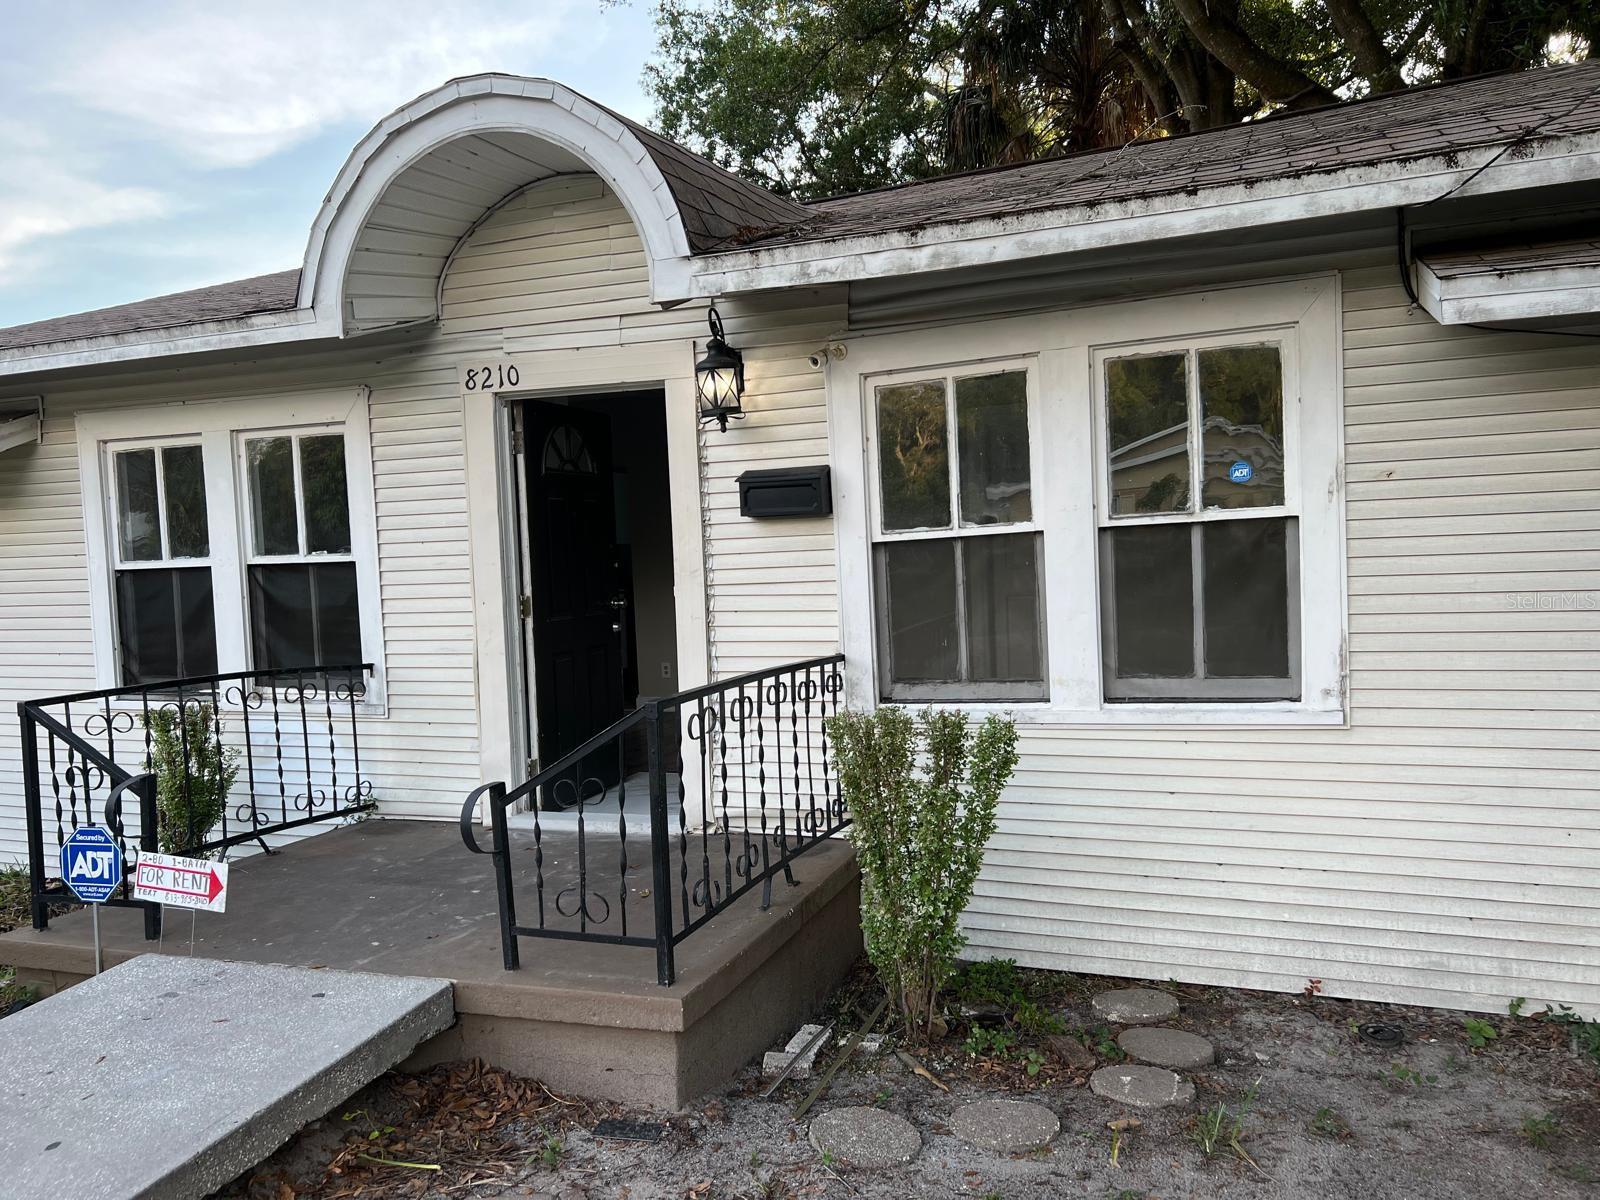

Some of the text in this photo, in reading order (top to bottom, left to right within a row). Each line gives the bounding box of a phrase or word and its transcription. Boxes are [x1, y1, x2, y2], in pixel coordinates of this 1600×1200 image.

[465, 364, 519, 390] 8210
[76, 833, 97, 841] Secured
[71, 851, 112, 879] ADT
[137, 888, 157, 896] TEXT
[140, 867, 210, 893] FOR RENT
